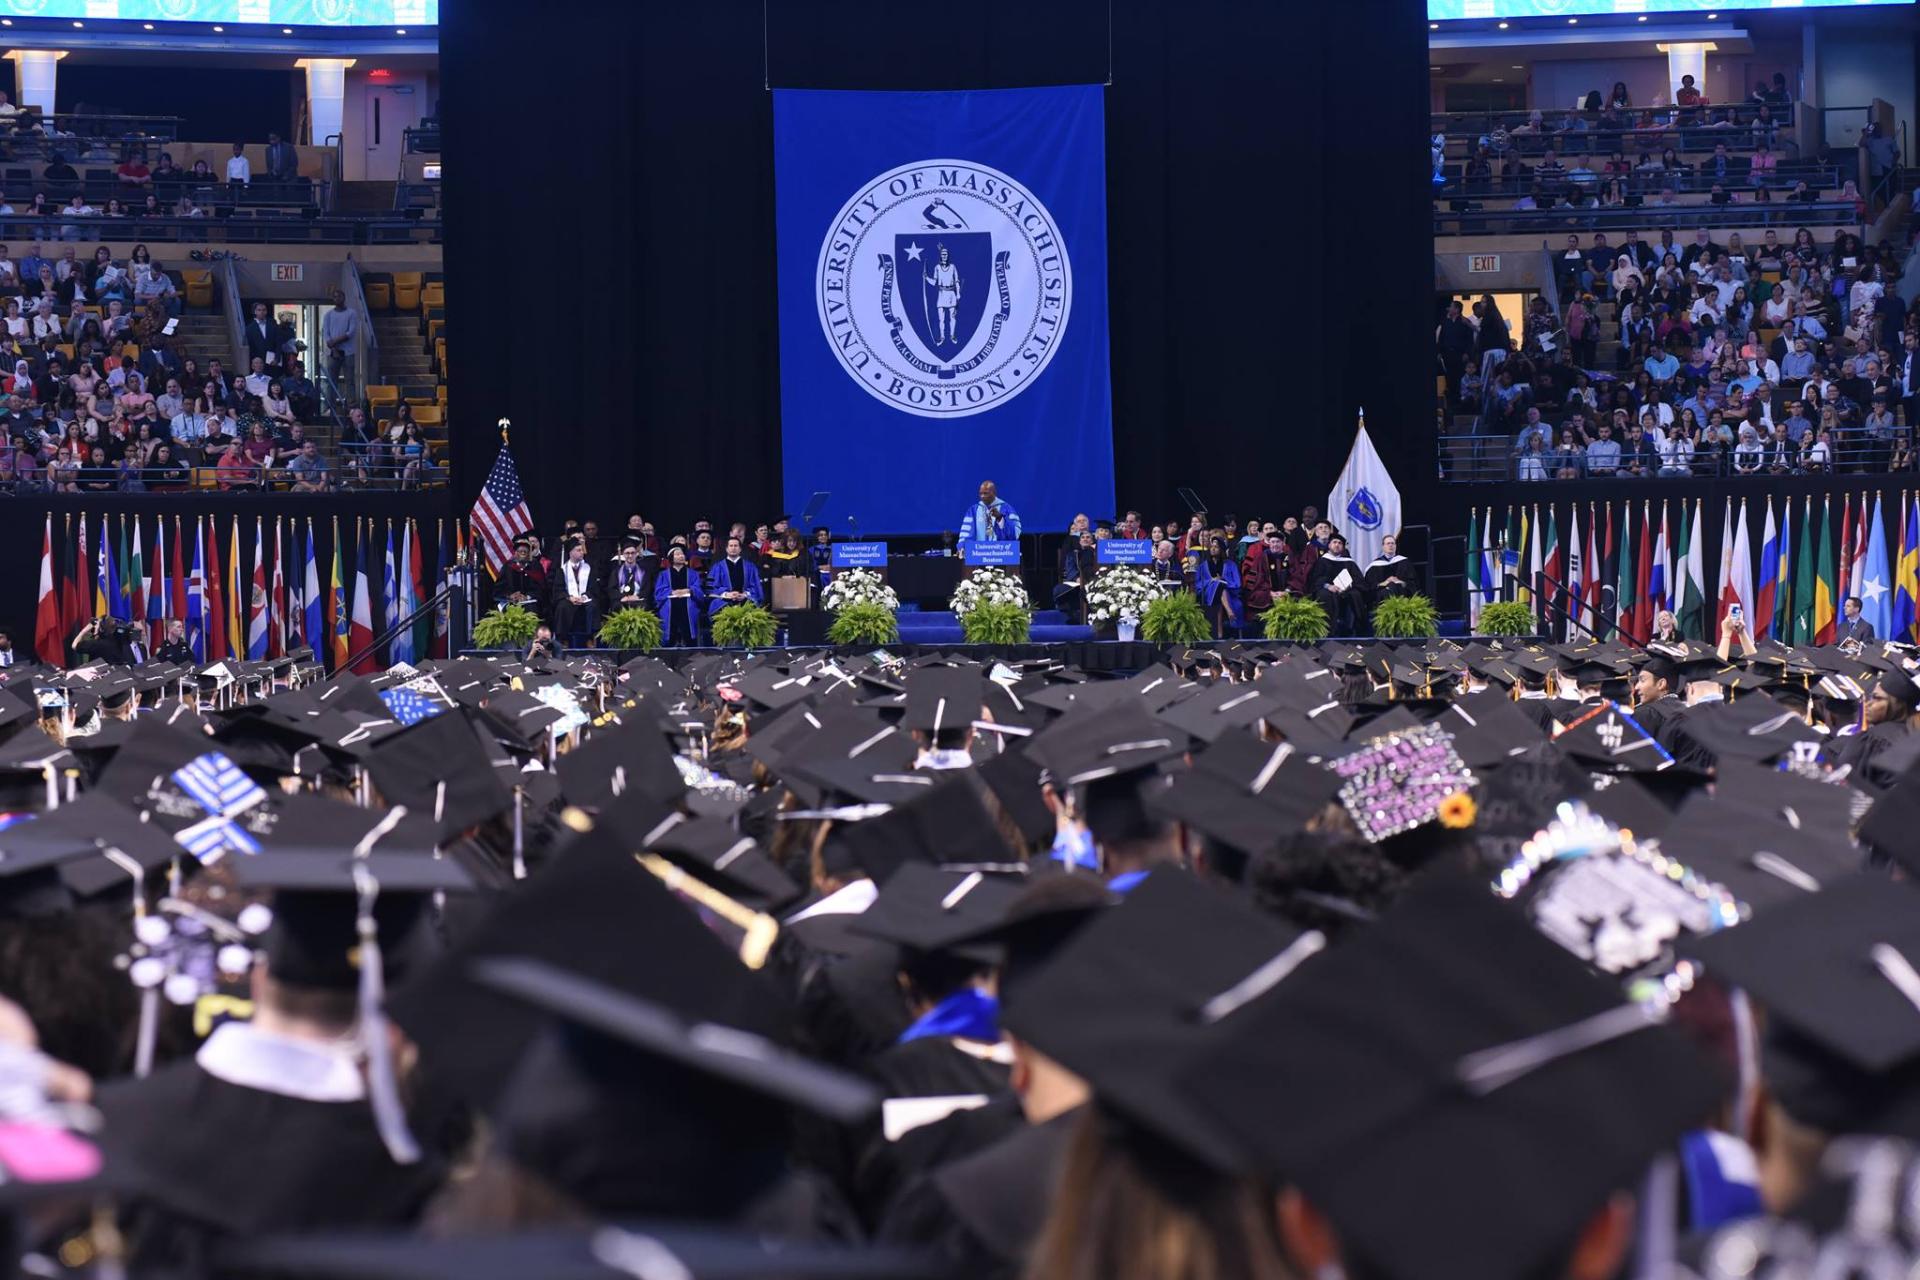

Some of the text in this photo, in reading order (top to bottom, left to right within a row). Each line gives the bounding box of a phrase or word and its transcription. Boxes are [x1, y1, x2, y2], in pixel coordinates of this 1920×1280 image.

[277, 265, 298, 280] EXIT
[827, 169, 1062, 371] UNIVERSITY OF MASSACHUSETTS
[1474, 256, 1496, 271] EXIT
[882, 261, 893, 317] ENSE PETIT
[893, 335, 932, 373] PLACIDAM
[979, 316, 1002, 362] LIBERTATE
[886, 374, 1006, 407] BOSTON
